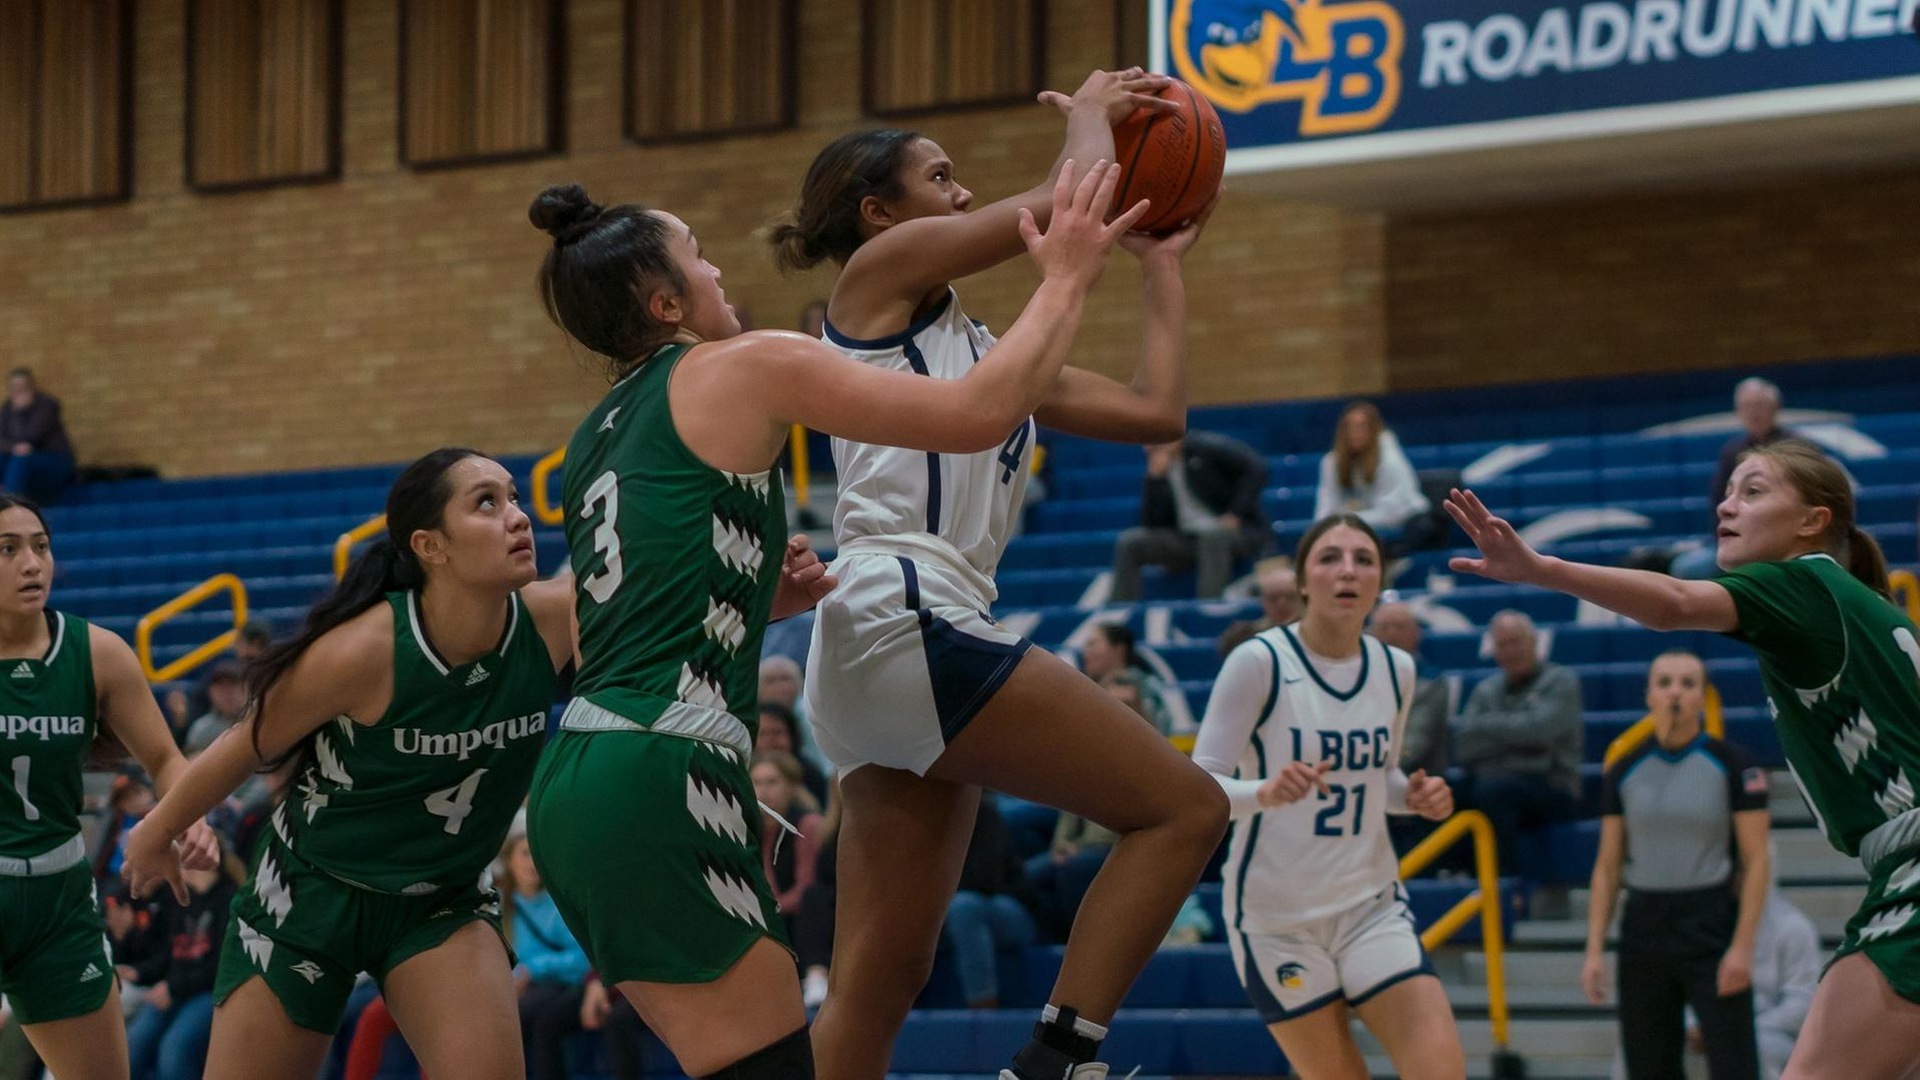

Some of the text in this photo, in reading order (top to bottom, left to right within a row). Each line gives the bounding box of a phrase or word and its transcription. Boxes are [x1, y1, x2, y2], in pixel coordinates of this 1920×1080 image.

[1419, 0, 1917, 87] ROADRUNNE
[998, 419, 1030, 485] 4
[580, 470, 623, 604] 3
[0, 714, 86, 740] pqua
[393, 711, 546, 761] Umpqua
[11, 755, 40, 821] 1
[424, 768, 489, 835] 4
[1314, 783, 1366, 836] 21
